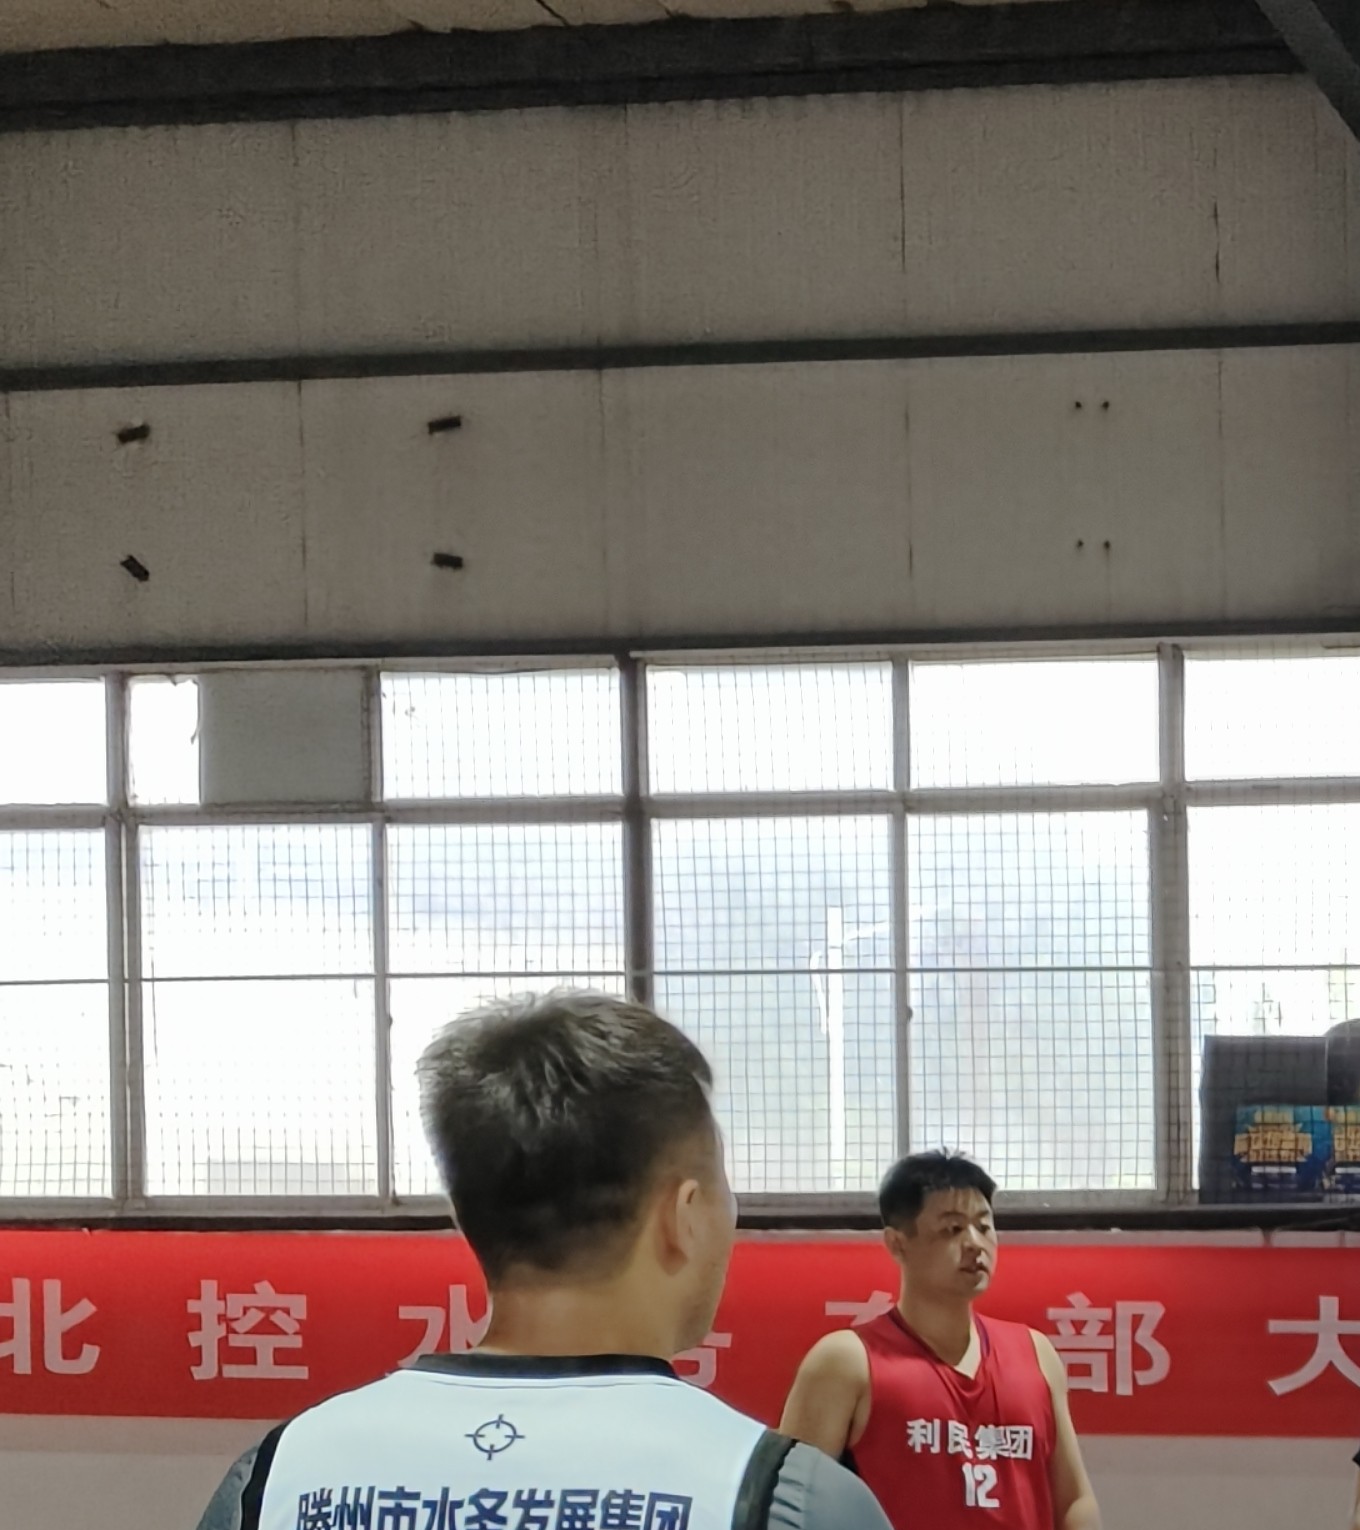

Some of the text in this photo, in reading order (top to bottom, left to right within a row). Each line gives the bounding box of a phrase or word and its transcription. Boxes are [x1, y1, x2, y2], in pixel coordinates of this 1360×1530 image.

[906, 1418, 1033, 1460] 利民集团
[962, 1461, 1000, 1508] 12
